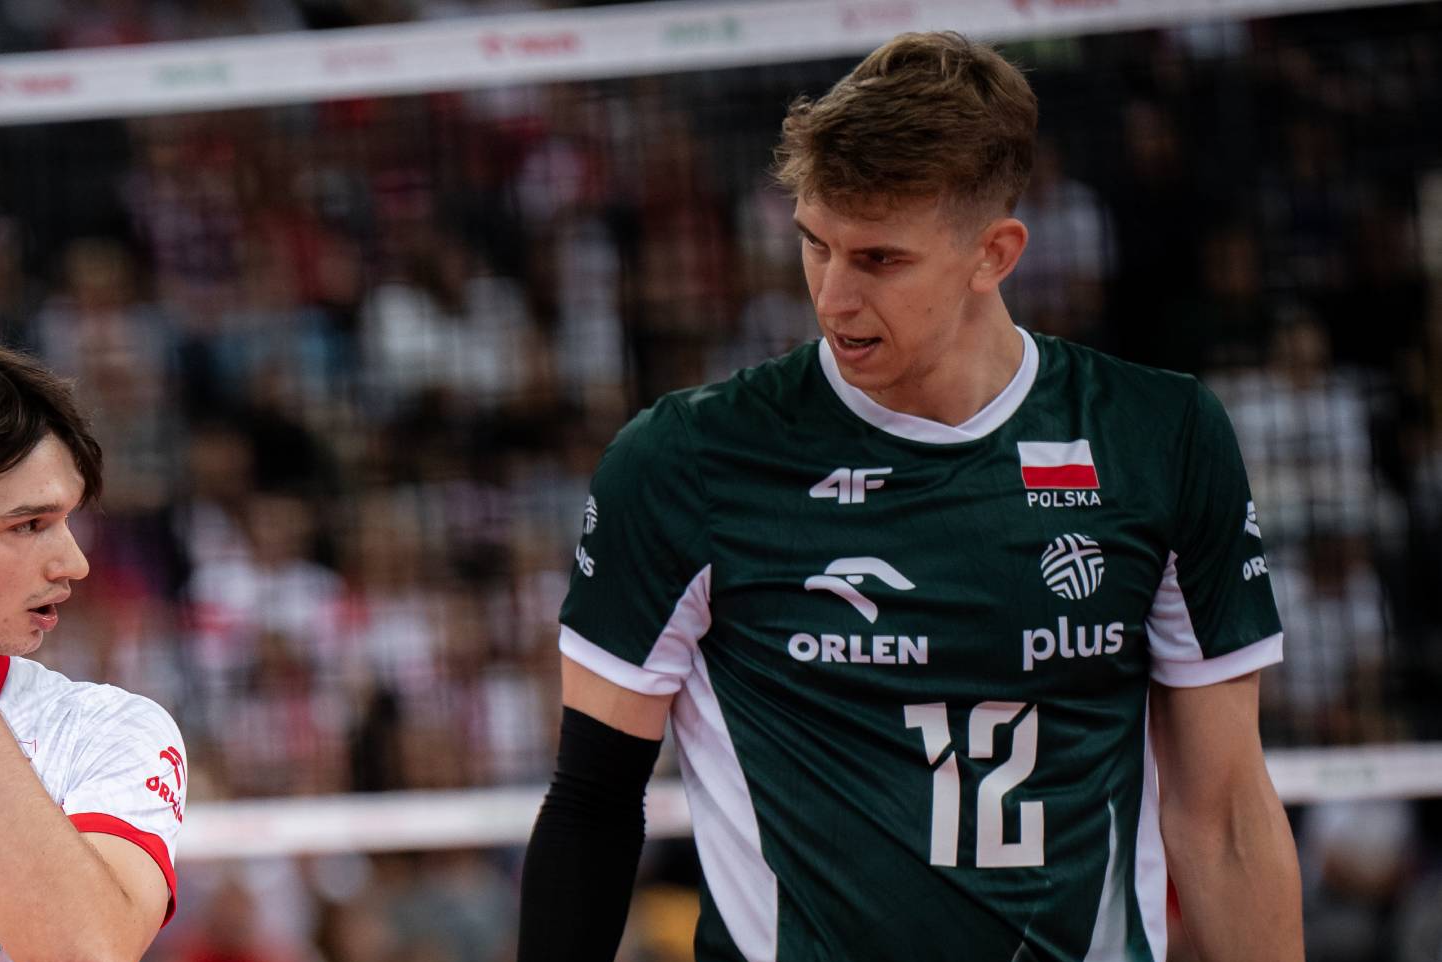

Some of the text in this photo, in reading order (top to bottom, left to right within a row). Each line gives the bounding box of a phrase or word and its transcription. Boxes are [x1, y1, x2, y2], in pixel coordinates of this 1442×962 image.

[809, 467, 893, 504] 4F
[1027, 491, 1102, 507] POLSKA
[788, 633, 928, 665] ORLEN
[1023, 616, 1124, 671] plus
[904, 701, 1045, 868] 12
